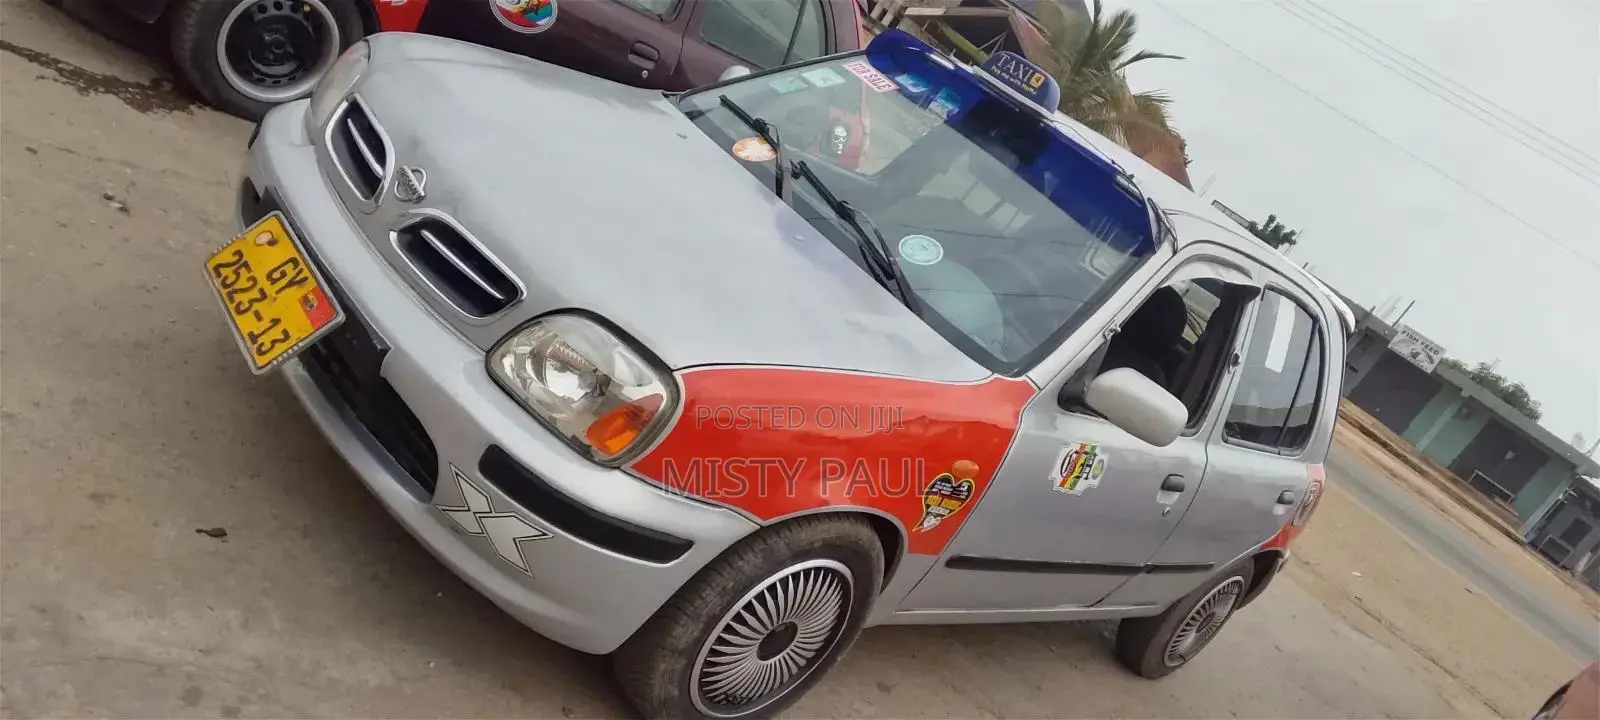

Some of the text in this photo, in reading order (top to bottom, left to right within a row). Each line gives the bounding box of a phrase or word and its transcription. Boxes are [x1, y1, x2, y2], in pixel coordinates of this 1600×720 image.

[851, 63, 892, 91] FOR SALE
[997, 53, 1033, 82] TAXI
[266, 257, 309, 294] GY
[213, 249, 291, 356] 2523-13
[1401, 329, 1440, 355] FISH FEED
